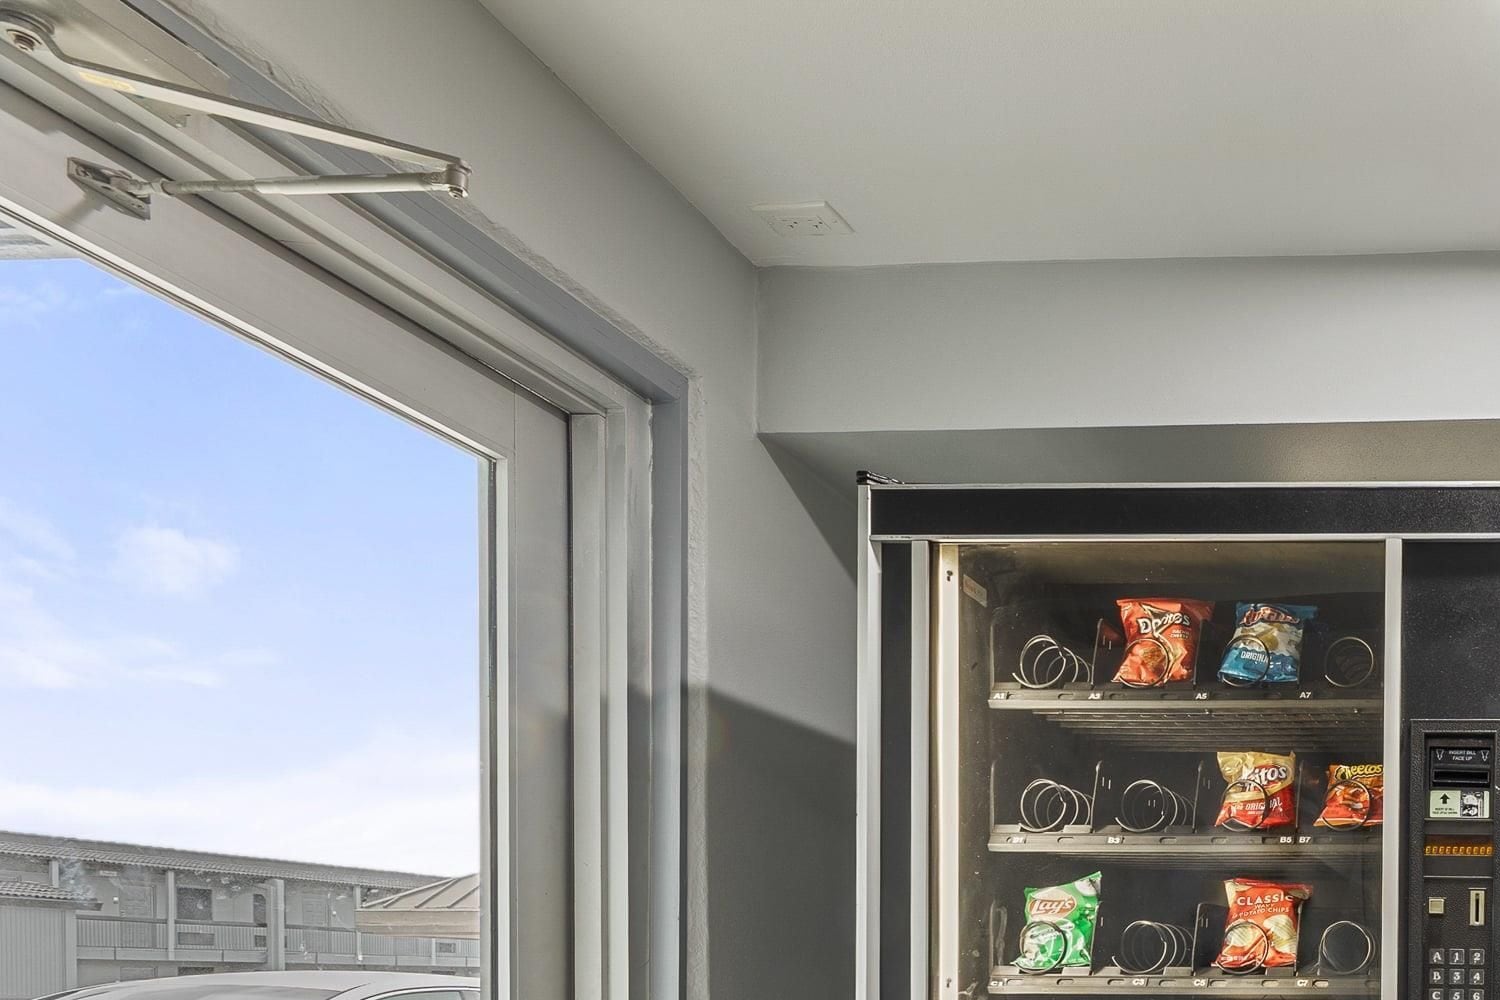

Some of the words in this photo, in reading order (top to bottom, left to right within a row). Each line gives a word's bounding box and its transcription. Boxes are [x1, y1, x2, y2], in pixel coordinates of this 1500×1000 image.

[1299, 691, 1311, 699] A7
[1237, 890, 1294, 906] CLASSIC
[1031, 898, 1074, 914] Lay's
[1433, 952, 1441, 961] A
[1454, 953, 1459, 962] 1
[1473, 953, 1481, 962] 2
[1433, 972, 1441, 981] B
[1453, 972, 1461, 981] 3
[1473, 973, 1480, 981] 4
[1193, 979, 1206, 987] C5
[1297, 979, 1308, 987] C7
[1432, 992, 1441, 1000] C
[1453, 992, 1460, 1000] 5
[1473, 992, 1480, 1000] 6
